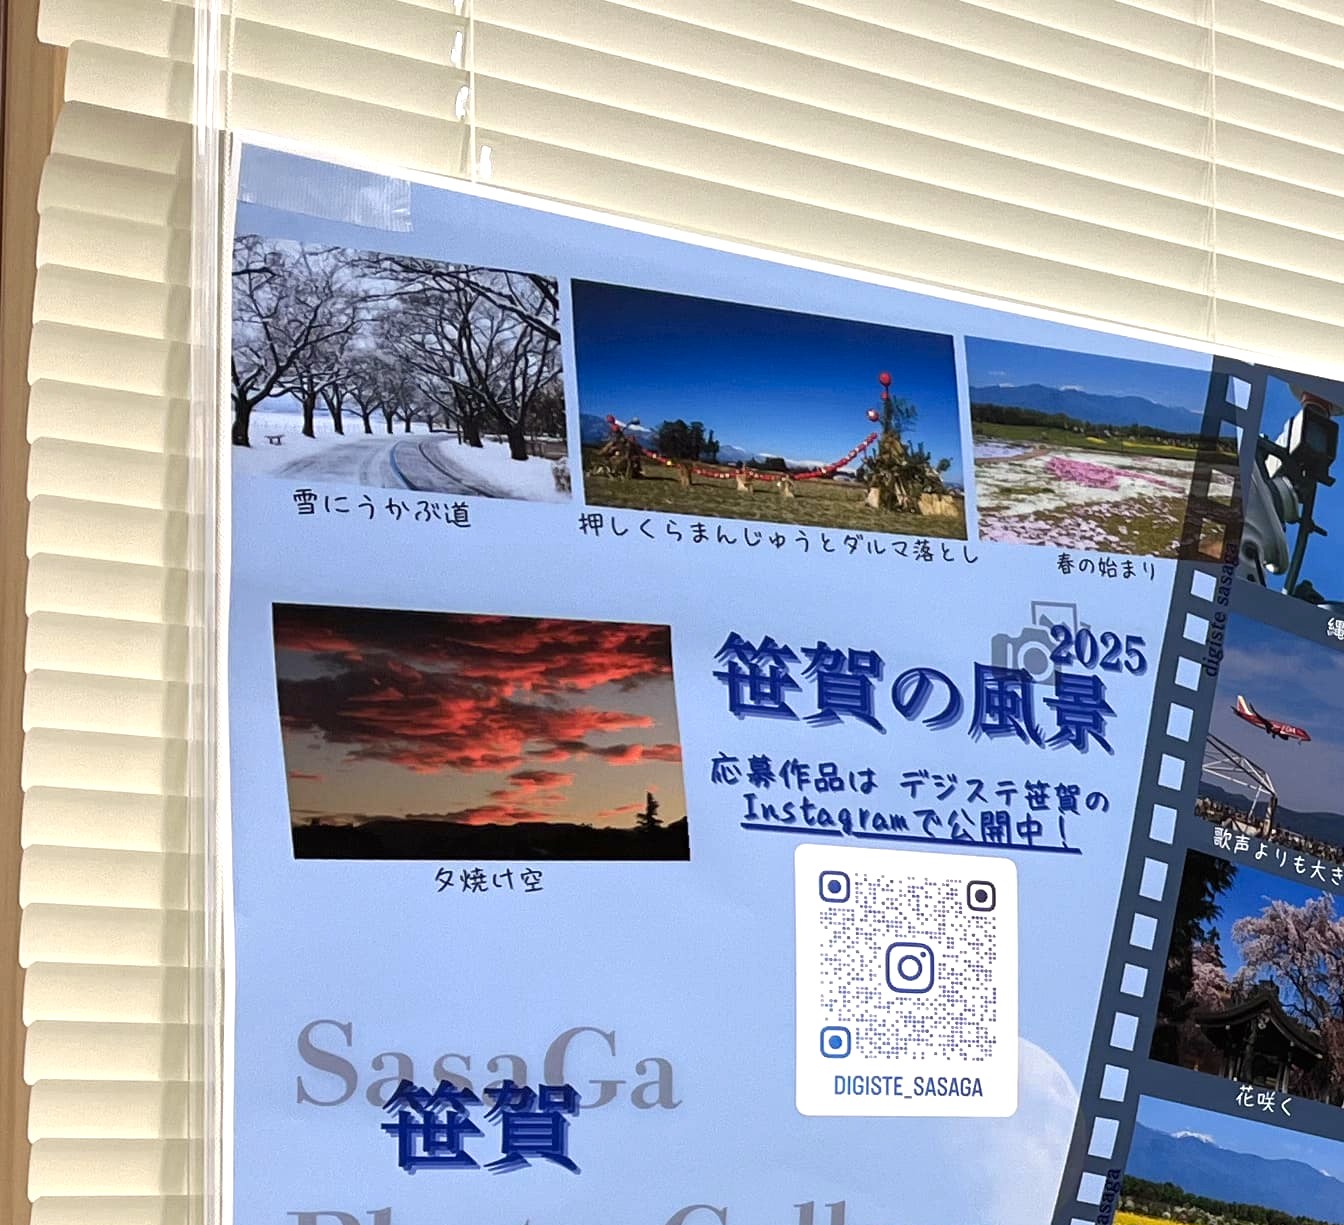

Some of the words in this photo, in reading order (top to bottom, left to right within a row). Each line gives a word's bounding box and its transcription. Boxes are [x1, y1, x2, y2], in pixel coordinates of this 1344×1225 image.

[292, 487, 472, 529] 雪にうかぶ道
[578, 512, 981, 566] 押しくらまんじゅうとダルマ落とし
[1056, 551, 1158, 582] 春の始まり
[1049, 622, 1148, 676] 2025
[1204, 608, 1228, 677] digiste
[711, 630, 1115, 756] 笹賀の風景
[709, 751, 879, 796] 応募作品は
[899, 769, 1111, 817] デジステ笹賀の
[433, 865, 545, 894] 夕焼け空
[295, 1019, 683, 1111] SasaGa
[833, 1073, 984, 1101] DIGISTE_SASAGA
[379, 1077, 582, 1175] 笹賀
[1235, 1085, 1293, 1117] 花咲く
